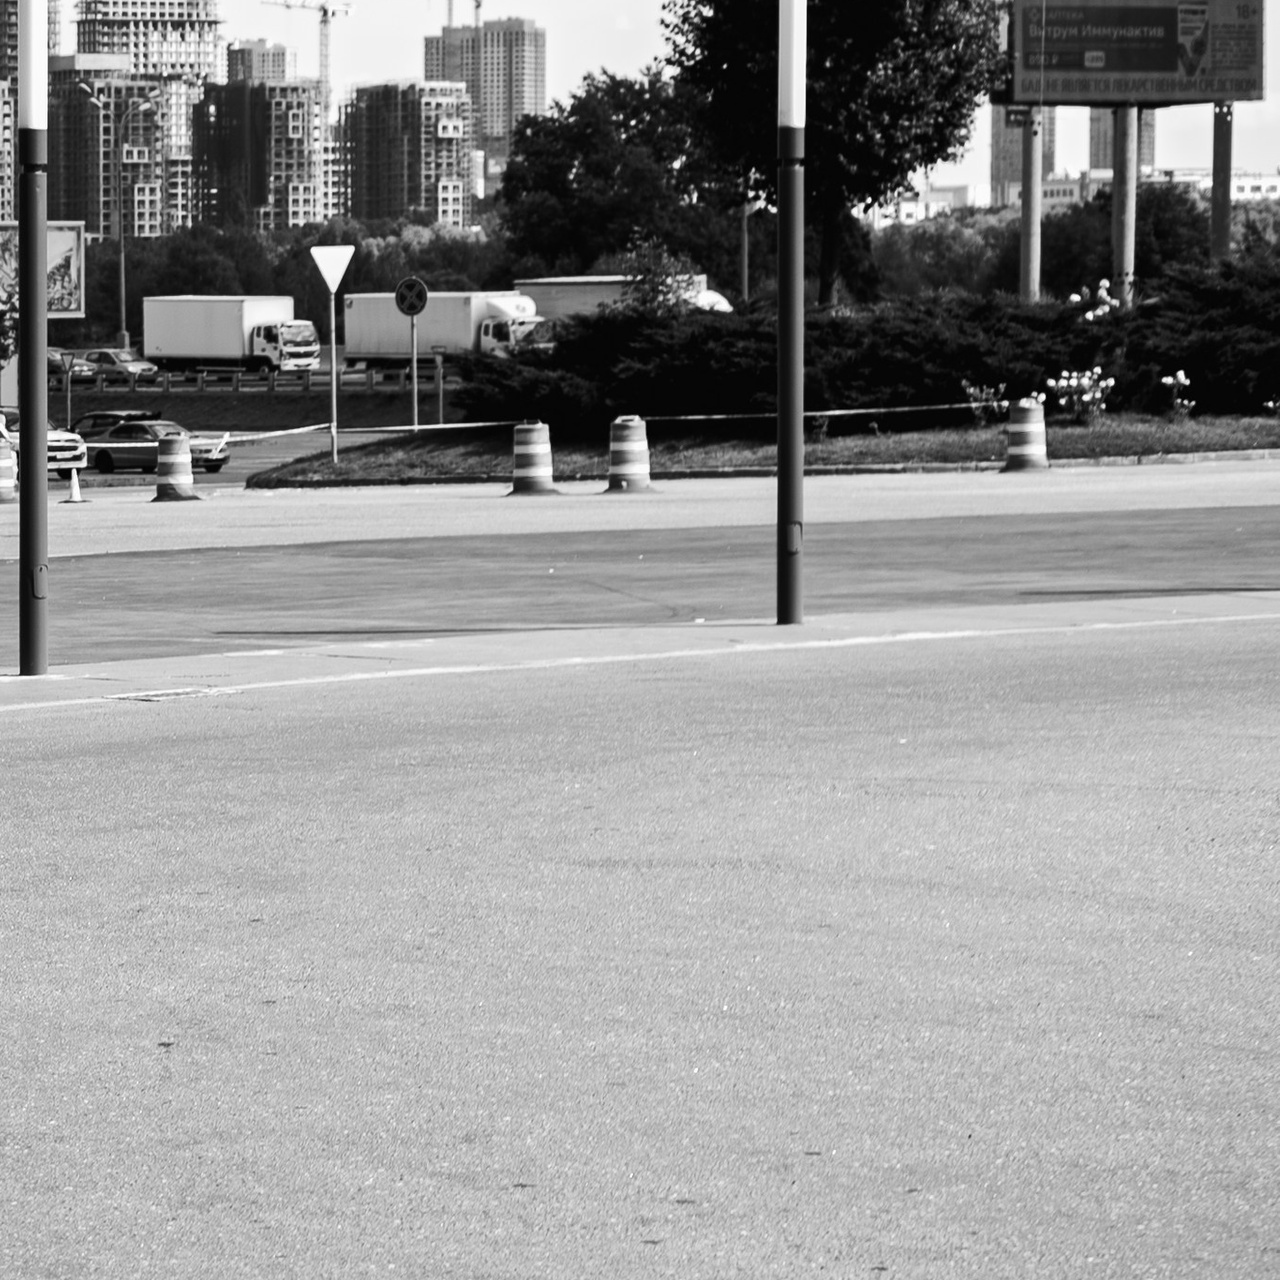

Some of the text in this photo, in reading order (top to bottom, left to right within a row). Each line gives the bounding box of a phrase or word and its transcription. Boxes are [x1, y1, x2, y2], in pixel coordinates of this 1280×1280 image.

[1236, 4, 1257, 19] 18+
[1029, 24, 1078, 40] Витрум
[1082, 24, 1164, 40] Иммунактив
[1061, 78, 1109, 93] ЯВЛЯЕТСЯ
